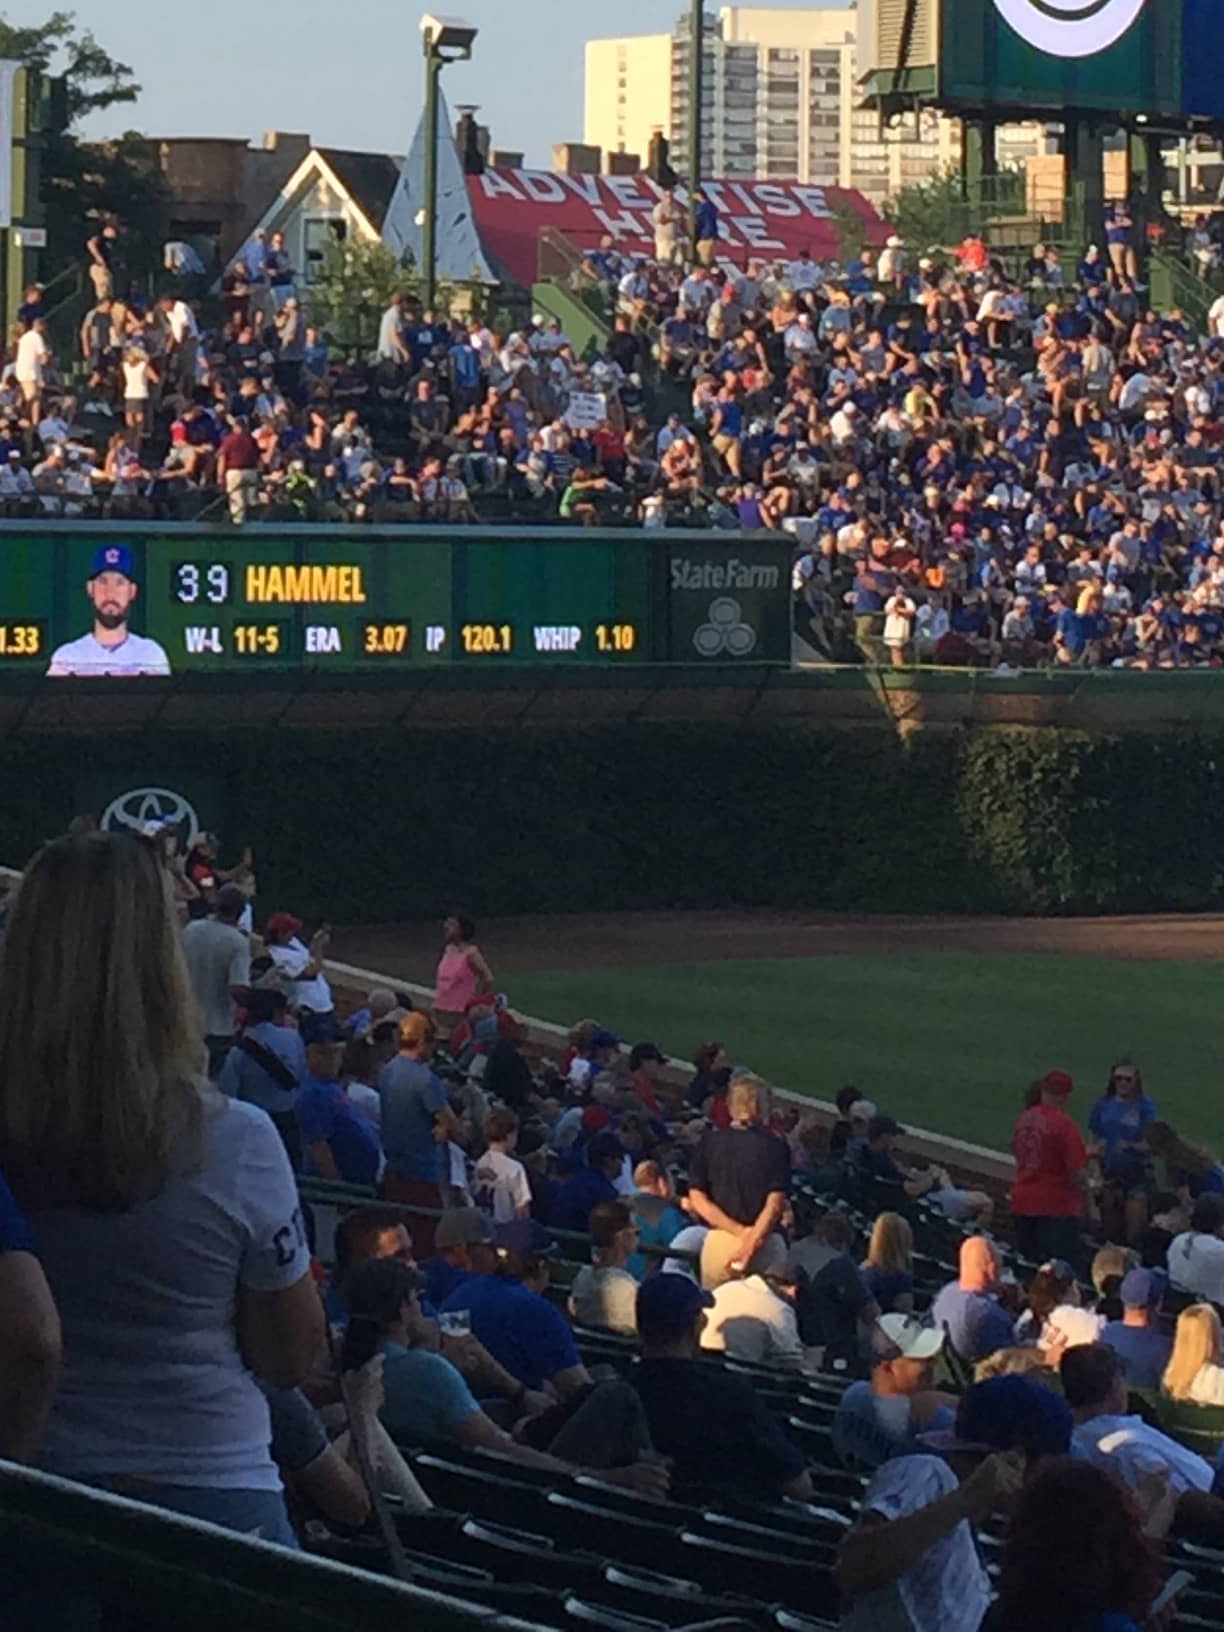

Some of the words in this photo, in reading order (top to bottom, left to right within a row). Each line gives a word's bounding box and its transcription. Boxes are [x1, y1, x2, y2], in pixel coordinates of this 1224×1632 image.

[176, 563, 229, 604] 39
[246, 564, 366, 603] HAMMEL
[185, 626, 223, 653] W-L
[234, 626, 279, 653] 11-5
[305, 626, 341, 653] ERA
[364, 625, 407, 653] 3.07
[426, 626, 446, 652] IP
[462, 625, 511, 652] 120.1
[533, 625, 582, 651] WHIP
[595, 625, 634, 650] 1.10
